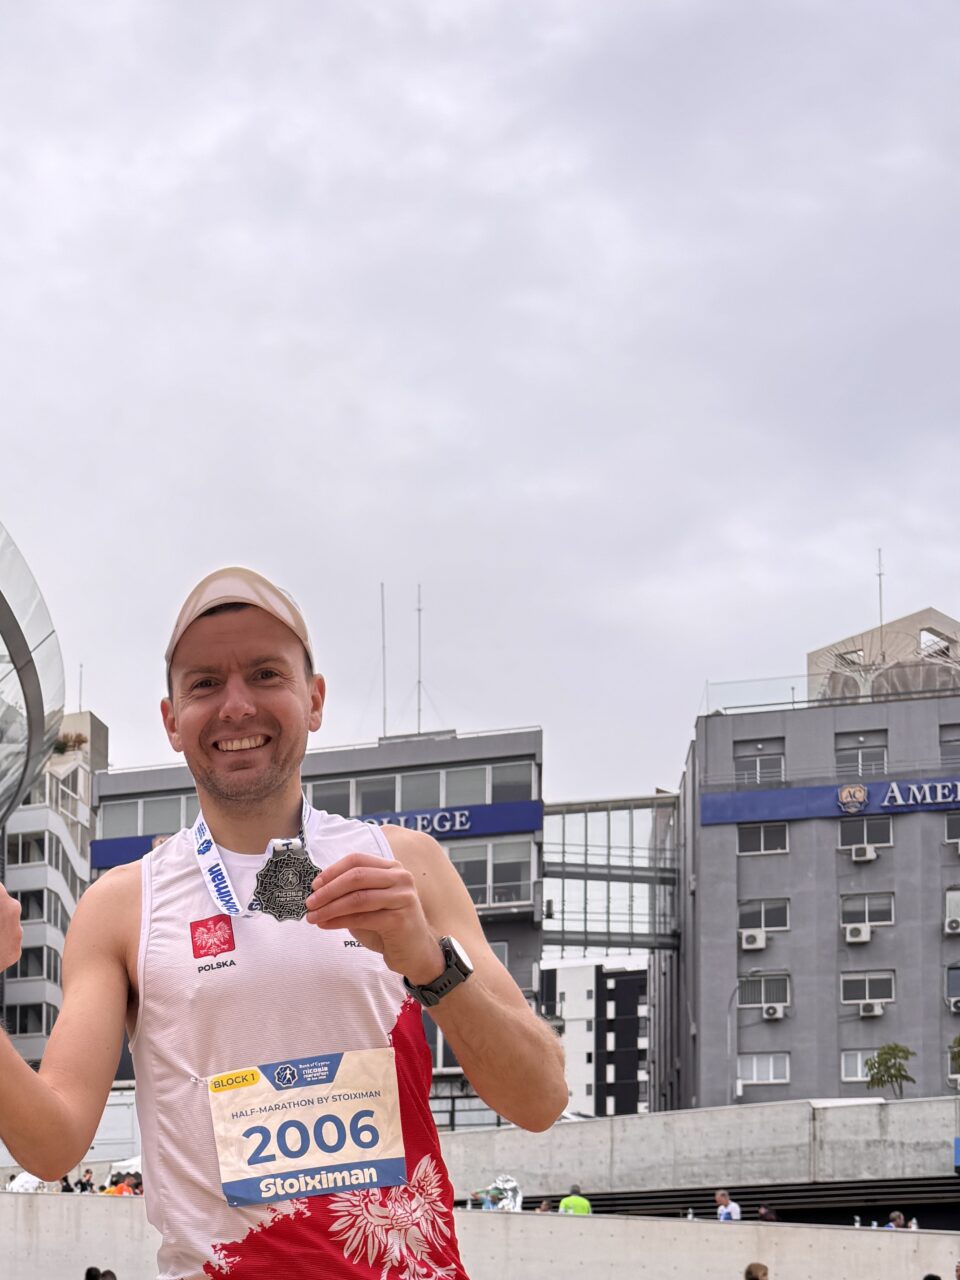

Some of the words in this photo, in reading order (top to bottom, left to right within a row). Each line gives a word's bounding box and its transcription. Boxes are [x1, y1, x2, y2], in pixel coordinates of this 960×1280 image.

[207, 863, 240, 915] oiximan
[343, 940, 363, 948] PRZ
[197, 959, 237, 974] POLSKA
[213, 1073, 248, 1089] BLOCK
[251, 1072, 256, 1081] 1
[231, 1098, 315, 1120] HALF-MARATHON
[316, 1096, 330, 1104] BY
[331, 1089, 381, 1103] STOIXIMAN
[241, 1109, 380, 1166] 2006
[259, 1167, 378, 1198] Stoiximan
